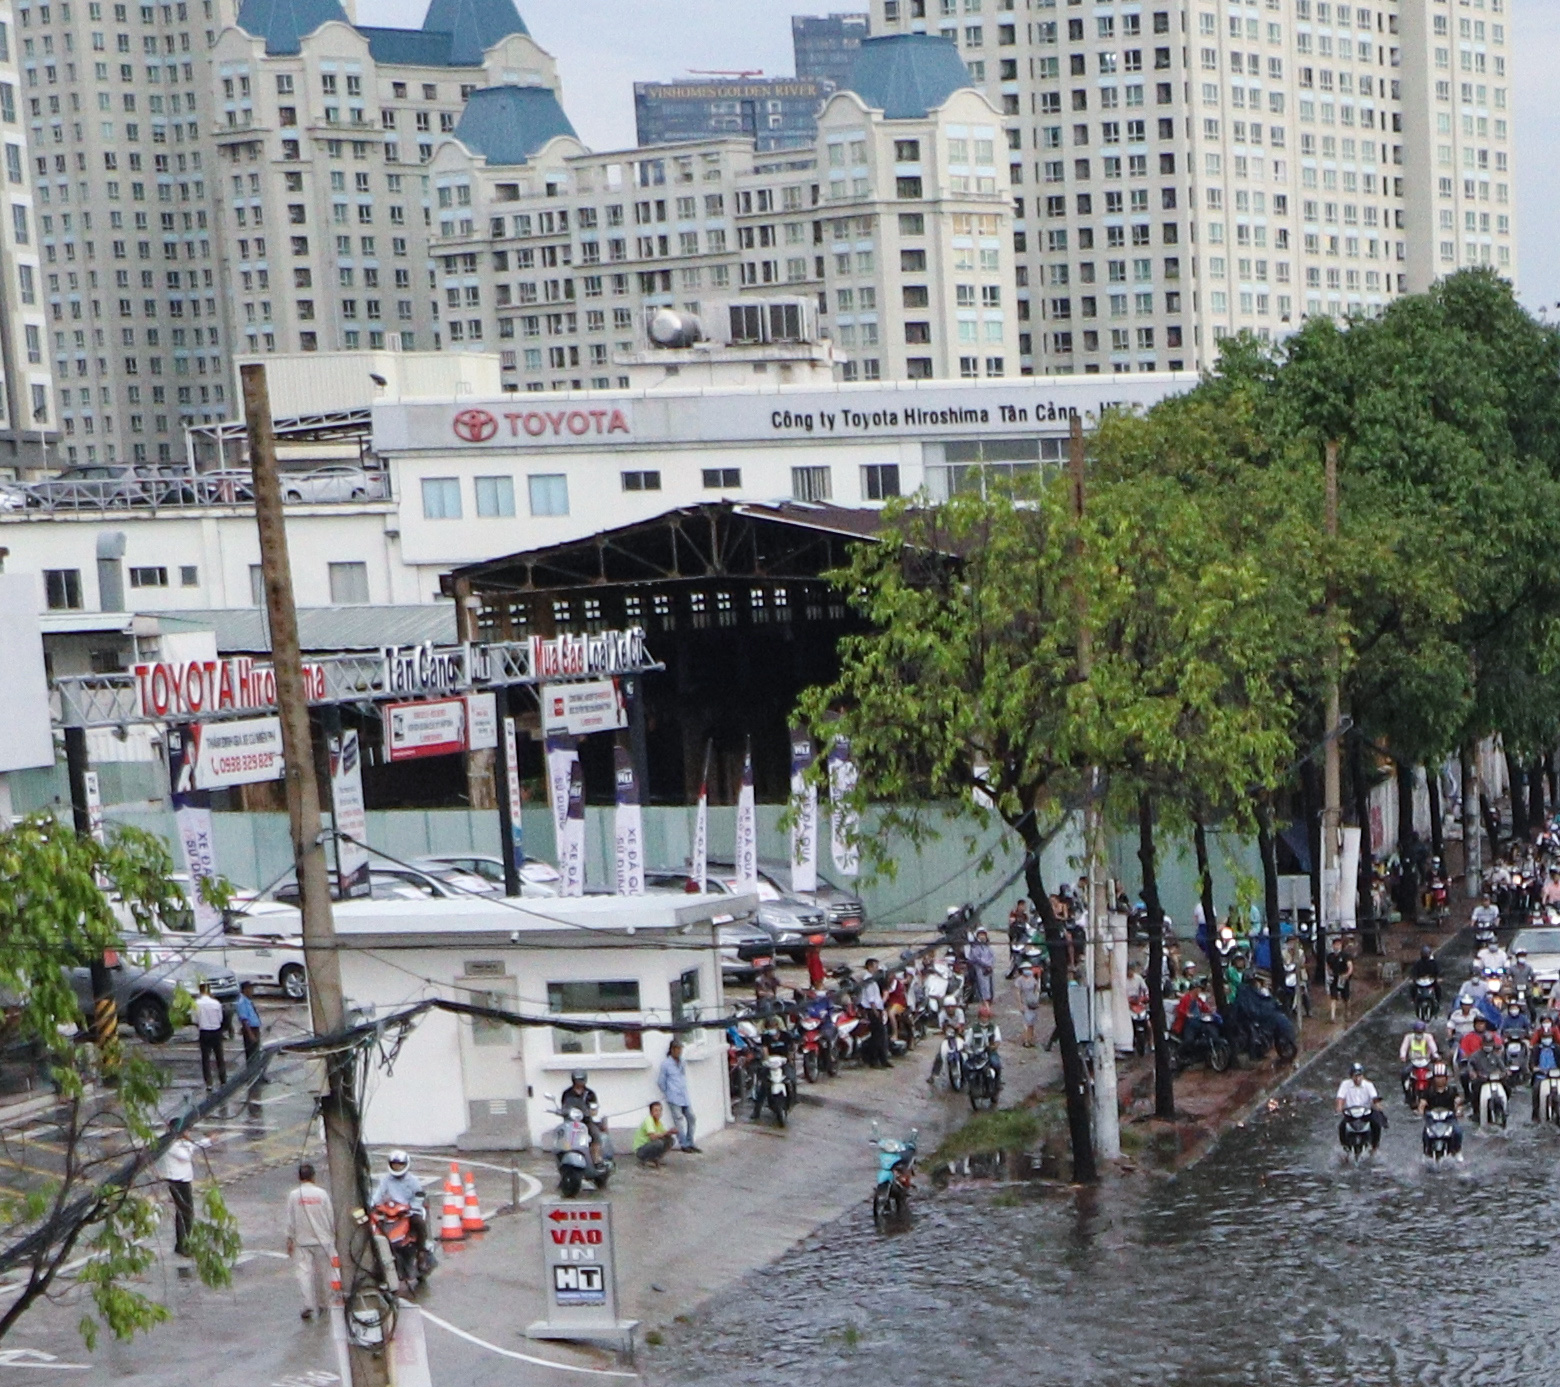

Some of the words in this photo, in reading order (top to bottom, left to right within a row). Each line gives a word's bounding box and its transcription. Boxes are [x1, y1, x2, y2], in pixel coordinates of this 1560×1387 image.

[504, 408, 630, 437] TOYOTA
[771, 409, 814, 432] Công
[820, 411, 836, 432] ty
[842, 408, 898, 430] Toyota
[904, 406, 989, 427] Hiroshima
[999, 403, 1027, 422] Tân
[1036, 400, 1077, 422] Cảng
[134, 660, 236, 717] TOYOTA
[531, 634, 559, 676] Mua
[197, 831, 209, 849] XE
[551, 1225, 602, 1245] VÀO
[560, 1249, 595, 1260] IN
[555, 1266, 603, 1291] HT
